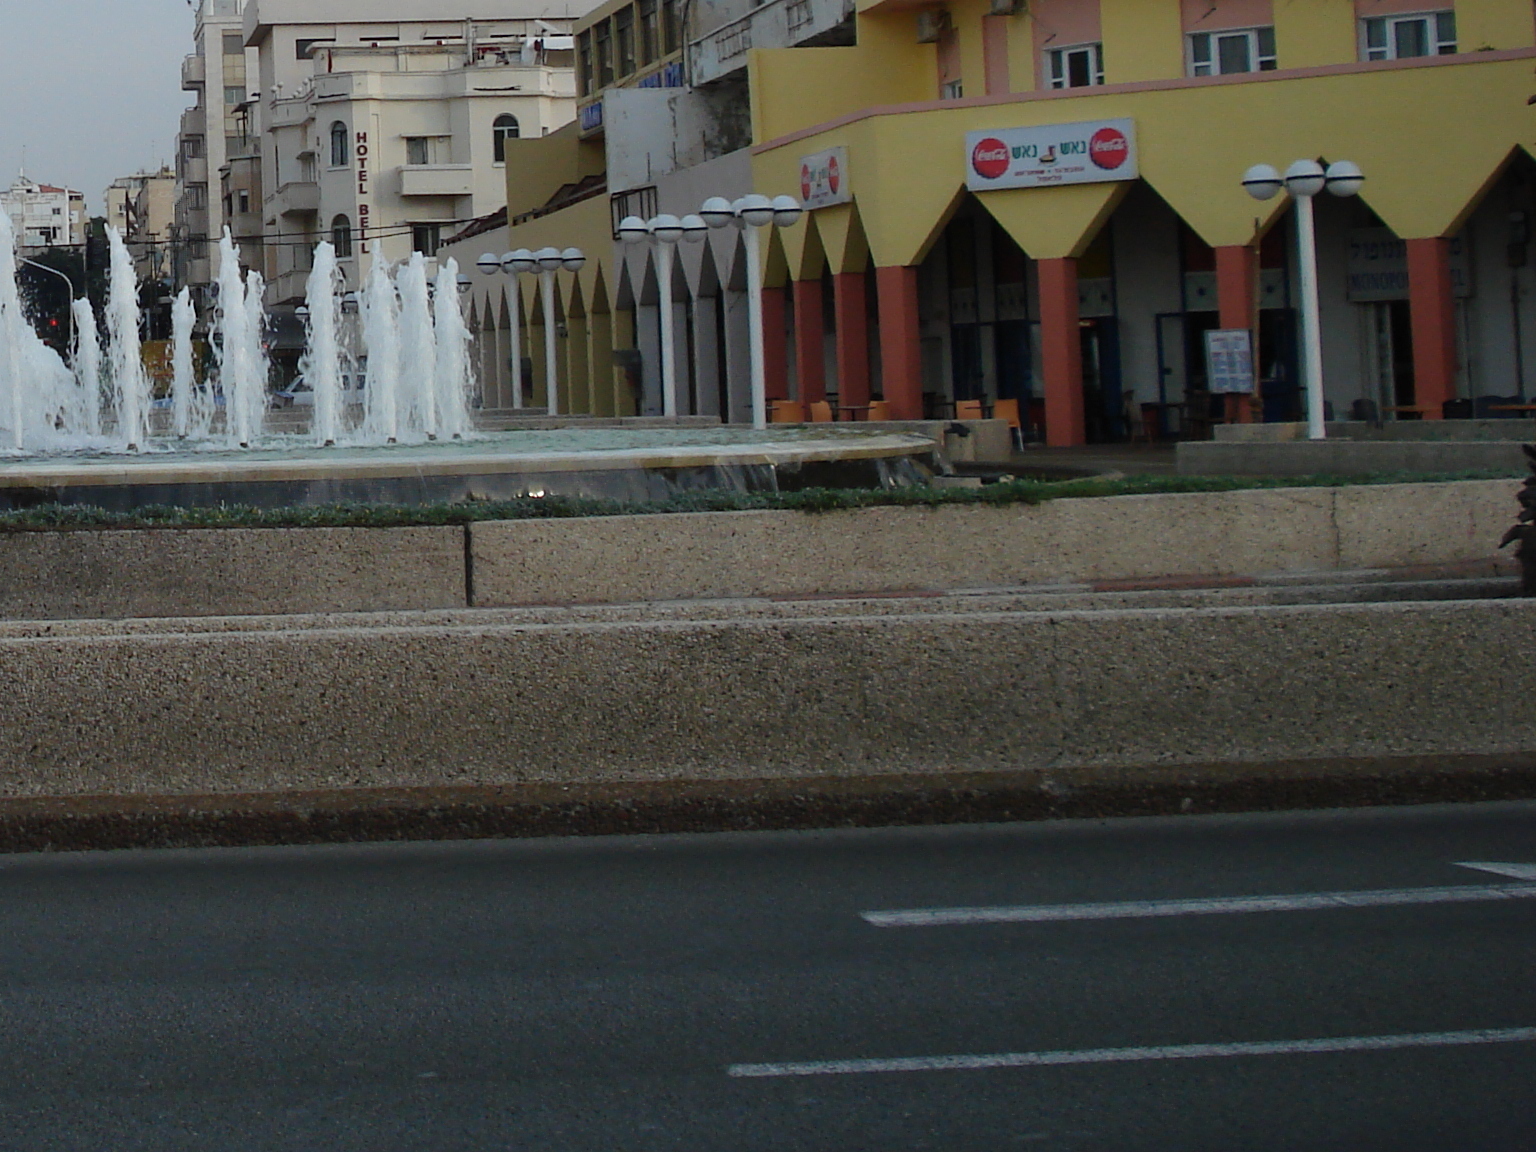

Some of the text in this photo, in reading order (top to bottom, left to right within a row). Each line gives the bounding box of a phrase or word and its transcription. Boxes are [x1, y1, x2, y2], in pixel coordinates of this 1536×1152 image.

[1012, 140, 1086, 159] נאש נאש
[356, 132, 370, 254] HOTEL BELL
